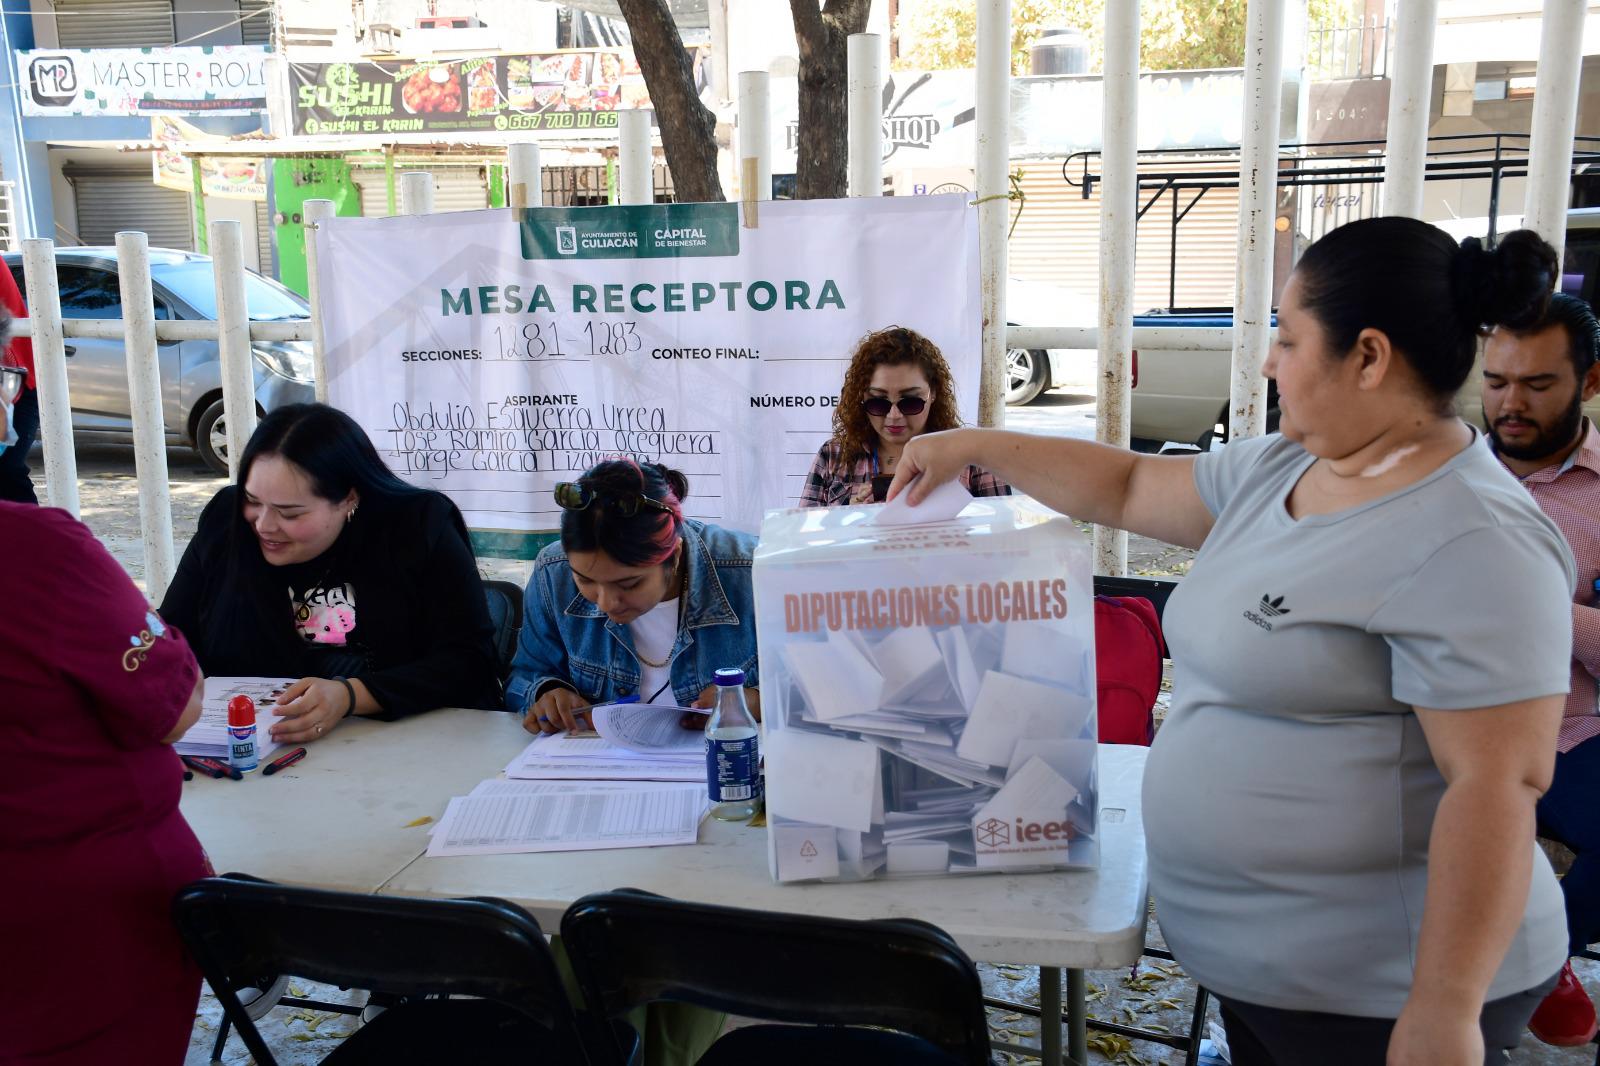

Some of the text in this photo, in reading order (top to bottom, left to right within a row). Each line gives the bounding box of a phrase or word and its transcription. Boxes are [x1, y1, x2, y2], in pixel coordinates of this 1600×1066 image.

[93, 62, 190, 88] MASTER
[298, 82, 393, 108] SUSHI
[319, 120, 360, 133] SUSHI
[362, 120, 379, 132] EL
[382, 119, 424, 133] KARIN
[508, 114, 541, 130] 667
[545, 113, 574, 129] 710
[577, 113, 591, 127] 11
[594, 112, 618, 127] 66
[654, 228, 706, 239] CAPITAL
[655, 239, 707, 248] DE BIENESTAR
[440, 279, 847, 317] MESA RECEPTORA
[401, 349, 482, 362] SECCIONES:
[651, 348, 760, 360] CONTEO FINAL:
[504, 394, 578, 407] ASPIRANTE
[750, 393, 838, 408] NÚMERO DE
[393, 402, 475, 430] Obdulio
[783, 578, 1068, 634] DIPUTACIONES LOCALES
[1243, 610, 1272, 632] adidas
[233, 743, 253, 754] TINTA
[1016, 817, 1077, 842] iees
